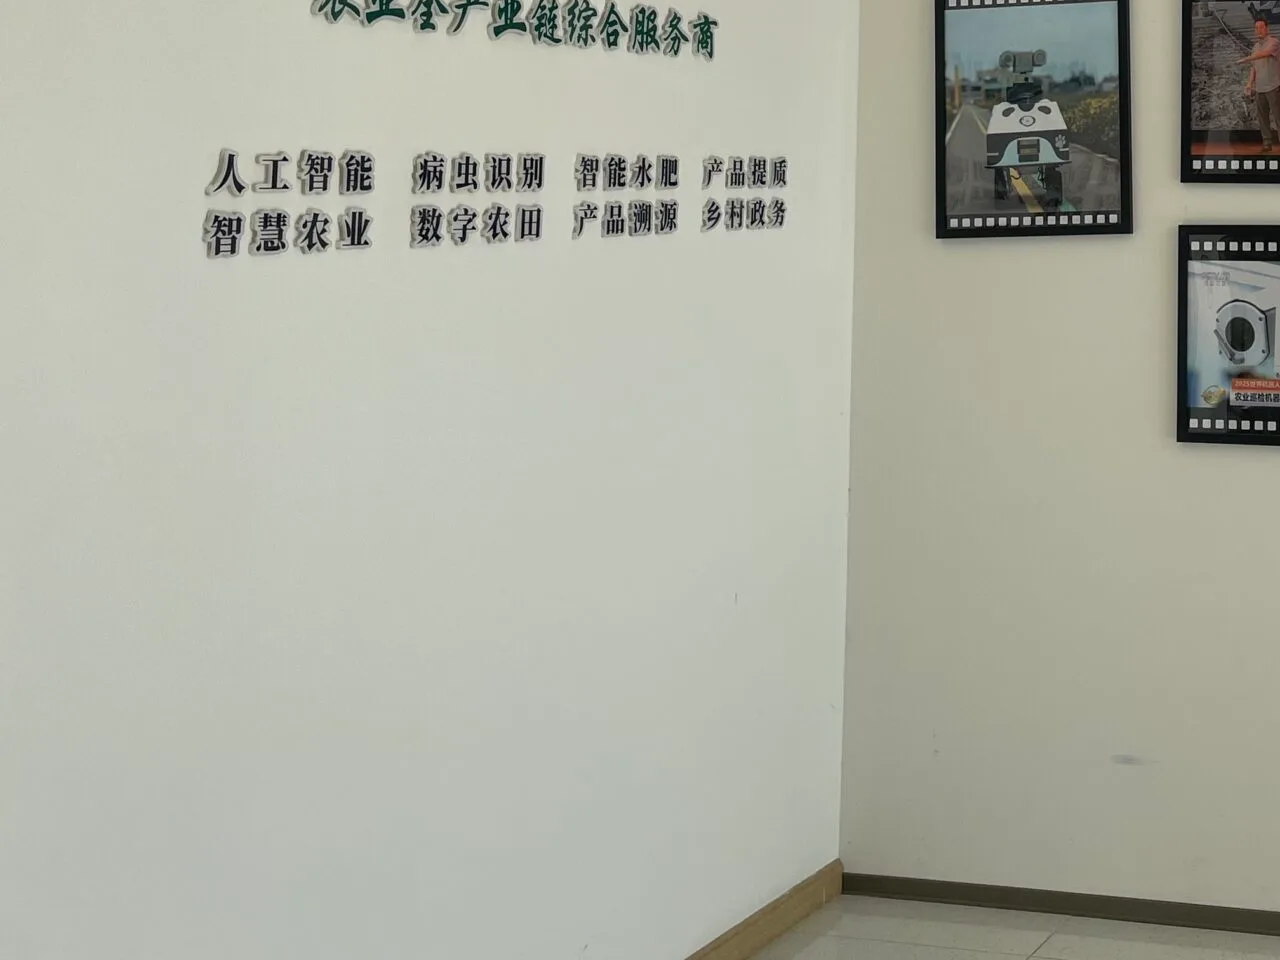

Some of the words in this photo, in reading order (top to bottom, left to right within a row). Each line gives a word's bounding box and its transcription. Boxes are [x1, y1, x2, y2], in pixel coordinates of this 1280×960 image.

[208, 151, 375, 195] 人工智能
[414, 152, 546, 193] 病虫识别
[576, 153, 681, 190] 智能水肥
[702, 154, 789, 190] 产品提质
[205, 209, 372, 257] 智慧农业
[414, 203, 545, 246] 数字农田
[575, 200, 679, 238] 产品溯源
[702, 197, 789, 231] 乡村政务
